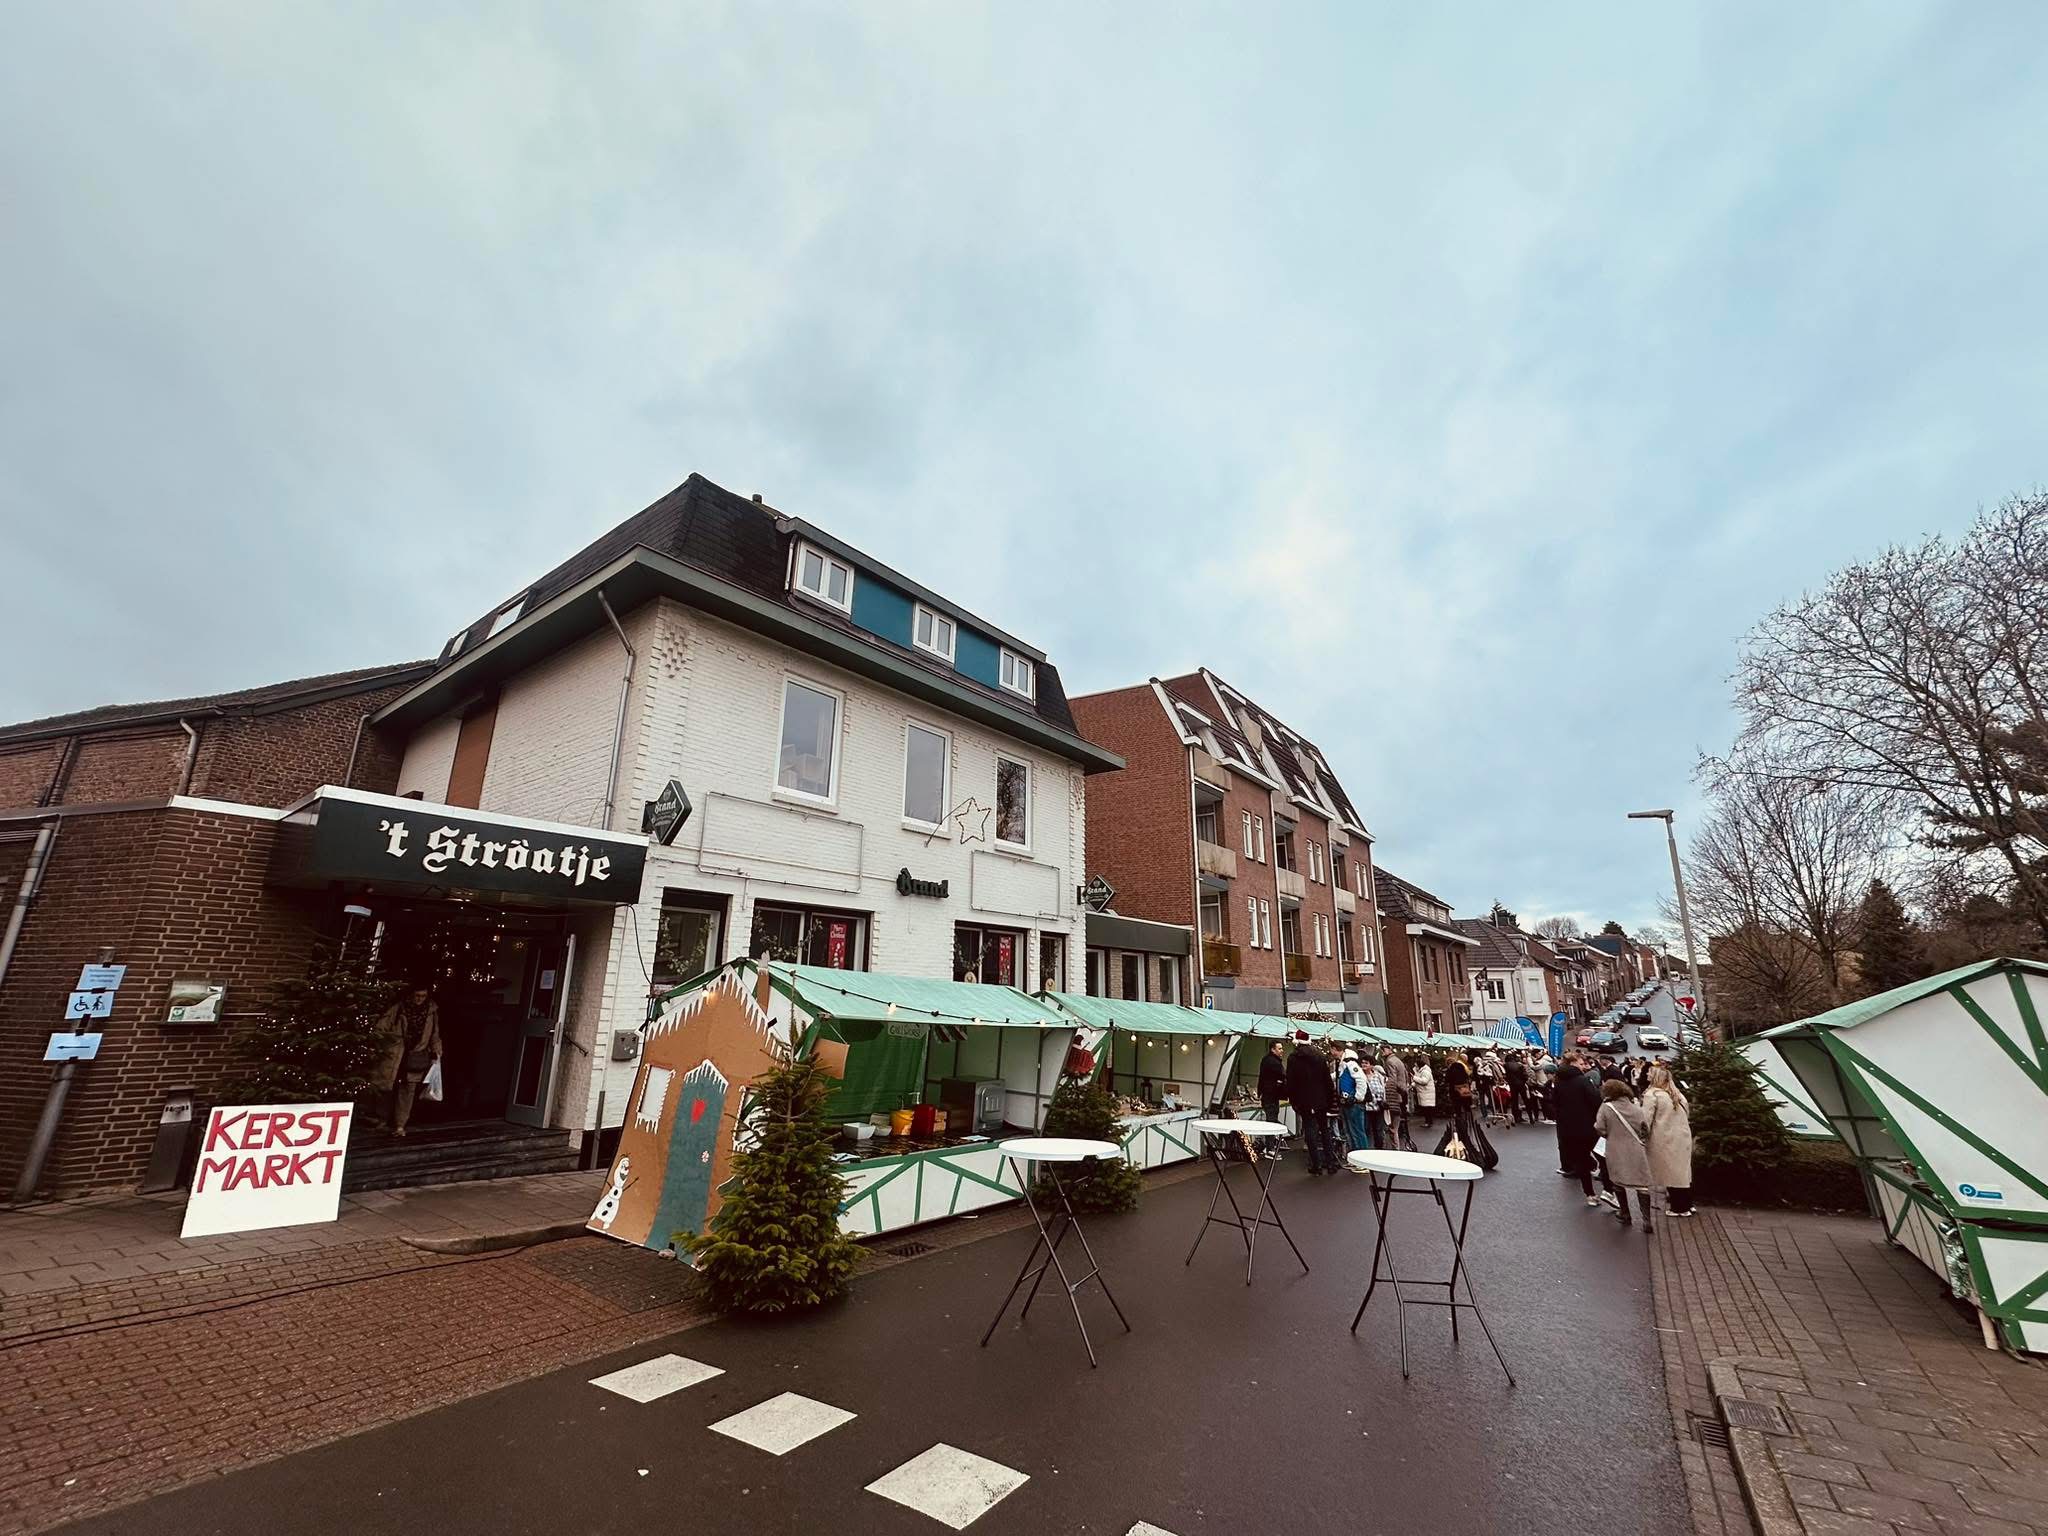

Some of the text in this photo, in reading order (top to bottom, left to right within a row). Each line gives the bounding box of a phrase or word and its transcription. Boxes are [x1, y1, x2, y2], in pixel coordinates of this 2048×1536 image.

[896, 867, 949, 898] Brand
[205, 1110, 350, 1152] KERST
[197, 1150, 343, 1193] MARKT
